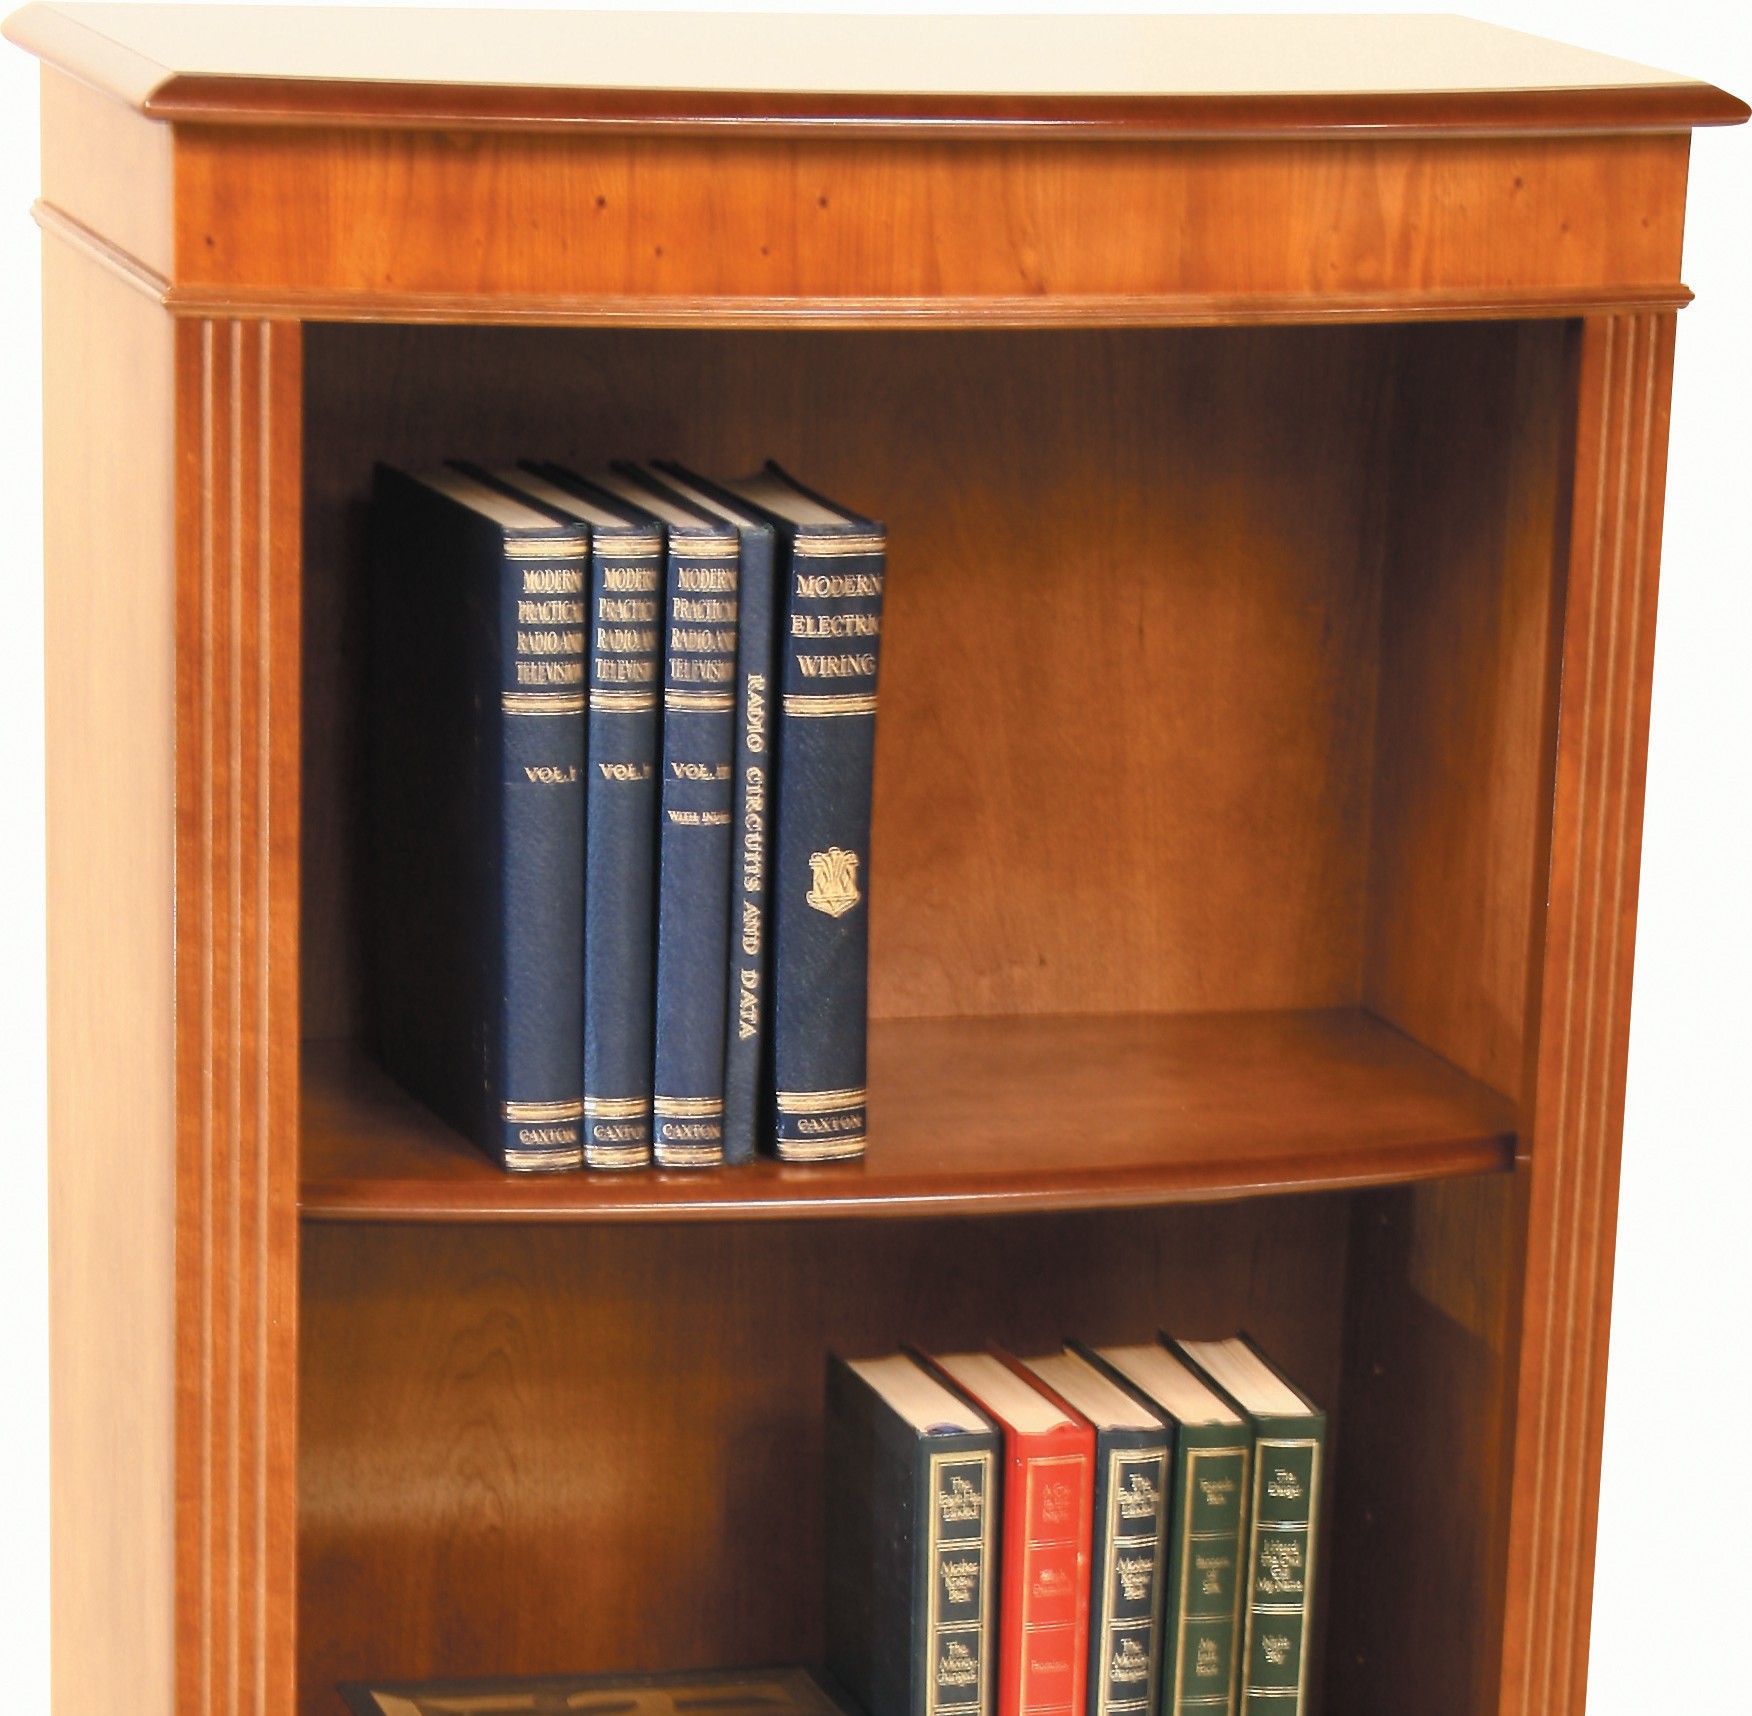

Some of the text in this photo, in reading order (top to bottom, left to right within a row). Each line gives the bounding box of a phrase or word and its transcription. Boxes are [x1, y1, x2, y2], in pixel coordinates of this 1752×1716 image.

[796, 573, 882, 598] MODERN
[516, 631, 558, 654] RADIO
[596, 628, 637, 653] RADIO
[670, 628, 713, 653] RADIO
[797, 654, 876, 678] WIRING
[738, 673, 766, 1041] RADIO CIRCUITS AND DATA
[519, 1128, 576, 1145] CAXTON
[797, 1115, 862, 1134] CAXTON
